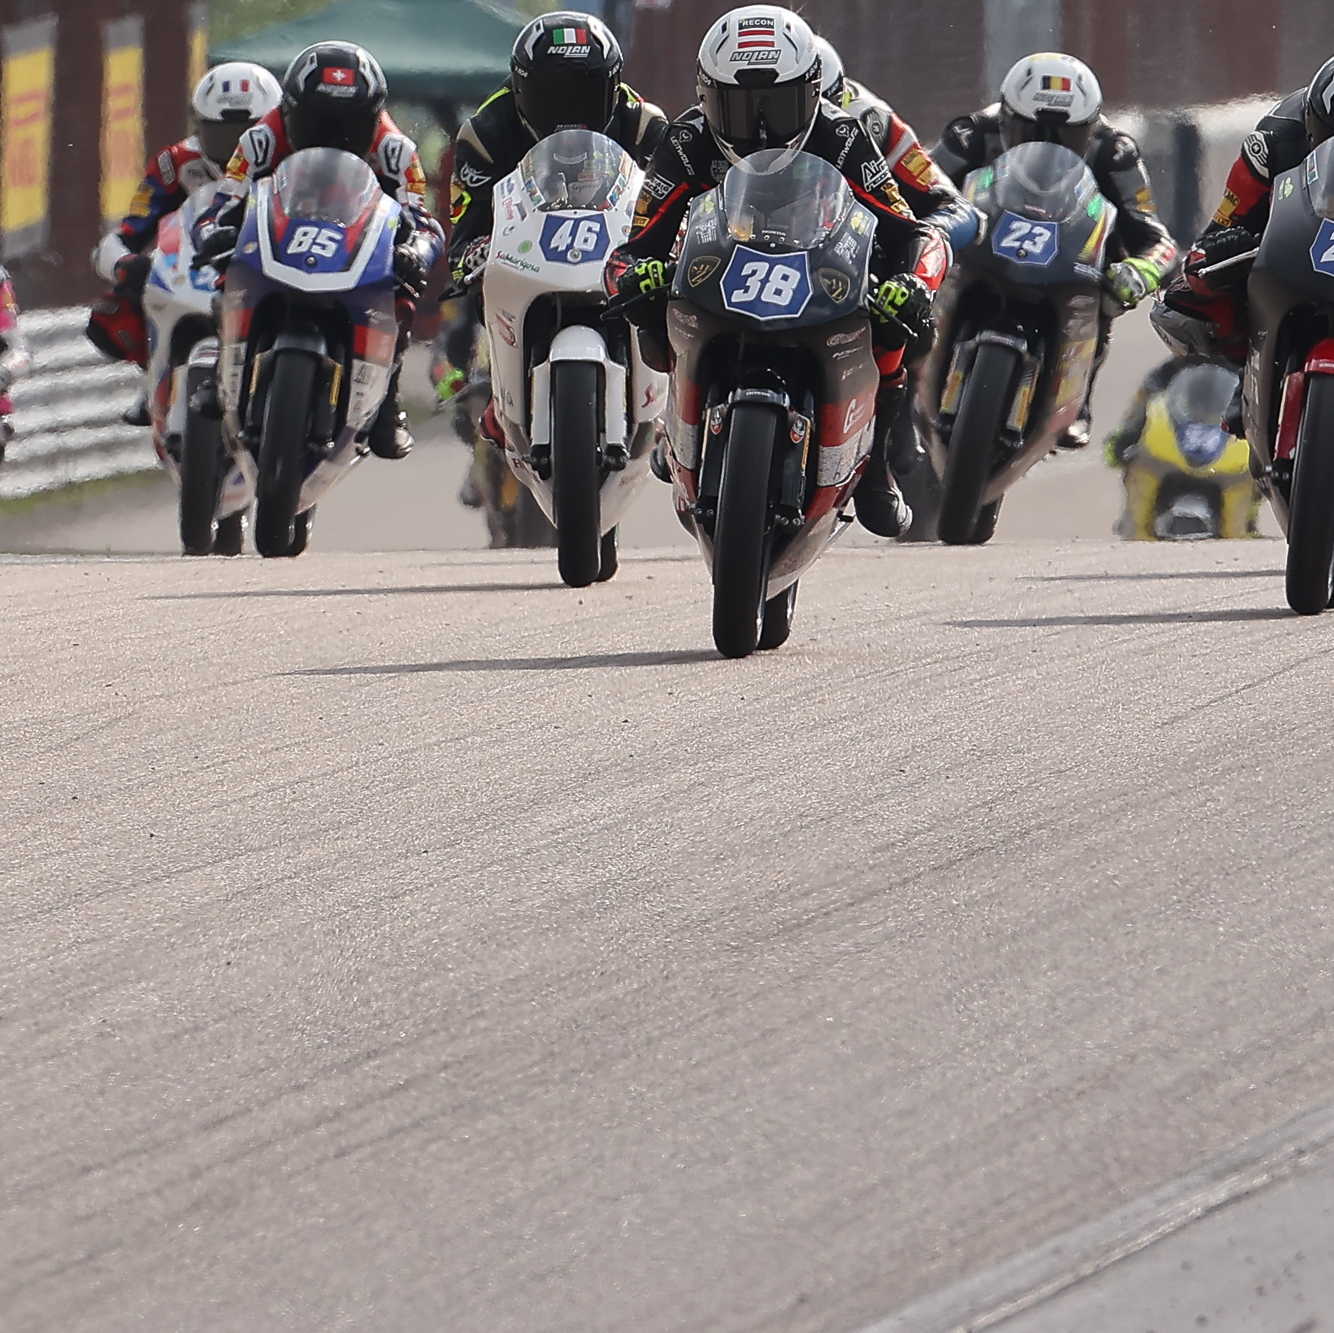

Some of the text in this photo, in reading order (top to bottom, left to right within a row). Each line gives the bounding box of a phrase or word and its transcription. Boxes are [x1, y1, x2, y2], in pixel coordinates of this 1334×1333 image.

[742, 19, 774, 27] RECON
[547, 46, 591, 58] NOLAN
[729, 50, 782, 65] NOLAN
[287, 226, 343, 259] 85
[549, 220, 600, 252] 46
[1000, 220, 1052, 254] 23
[731, 261, 801, 306] 38
